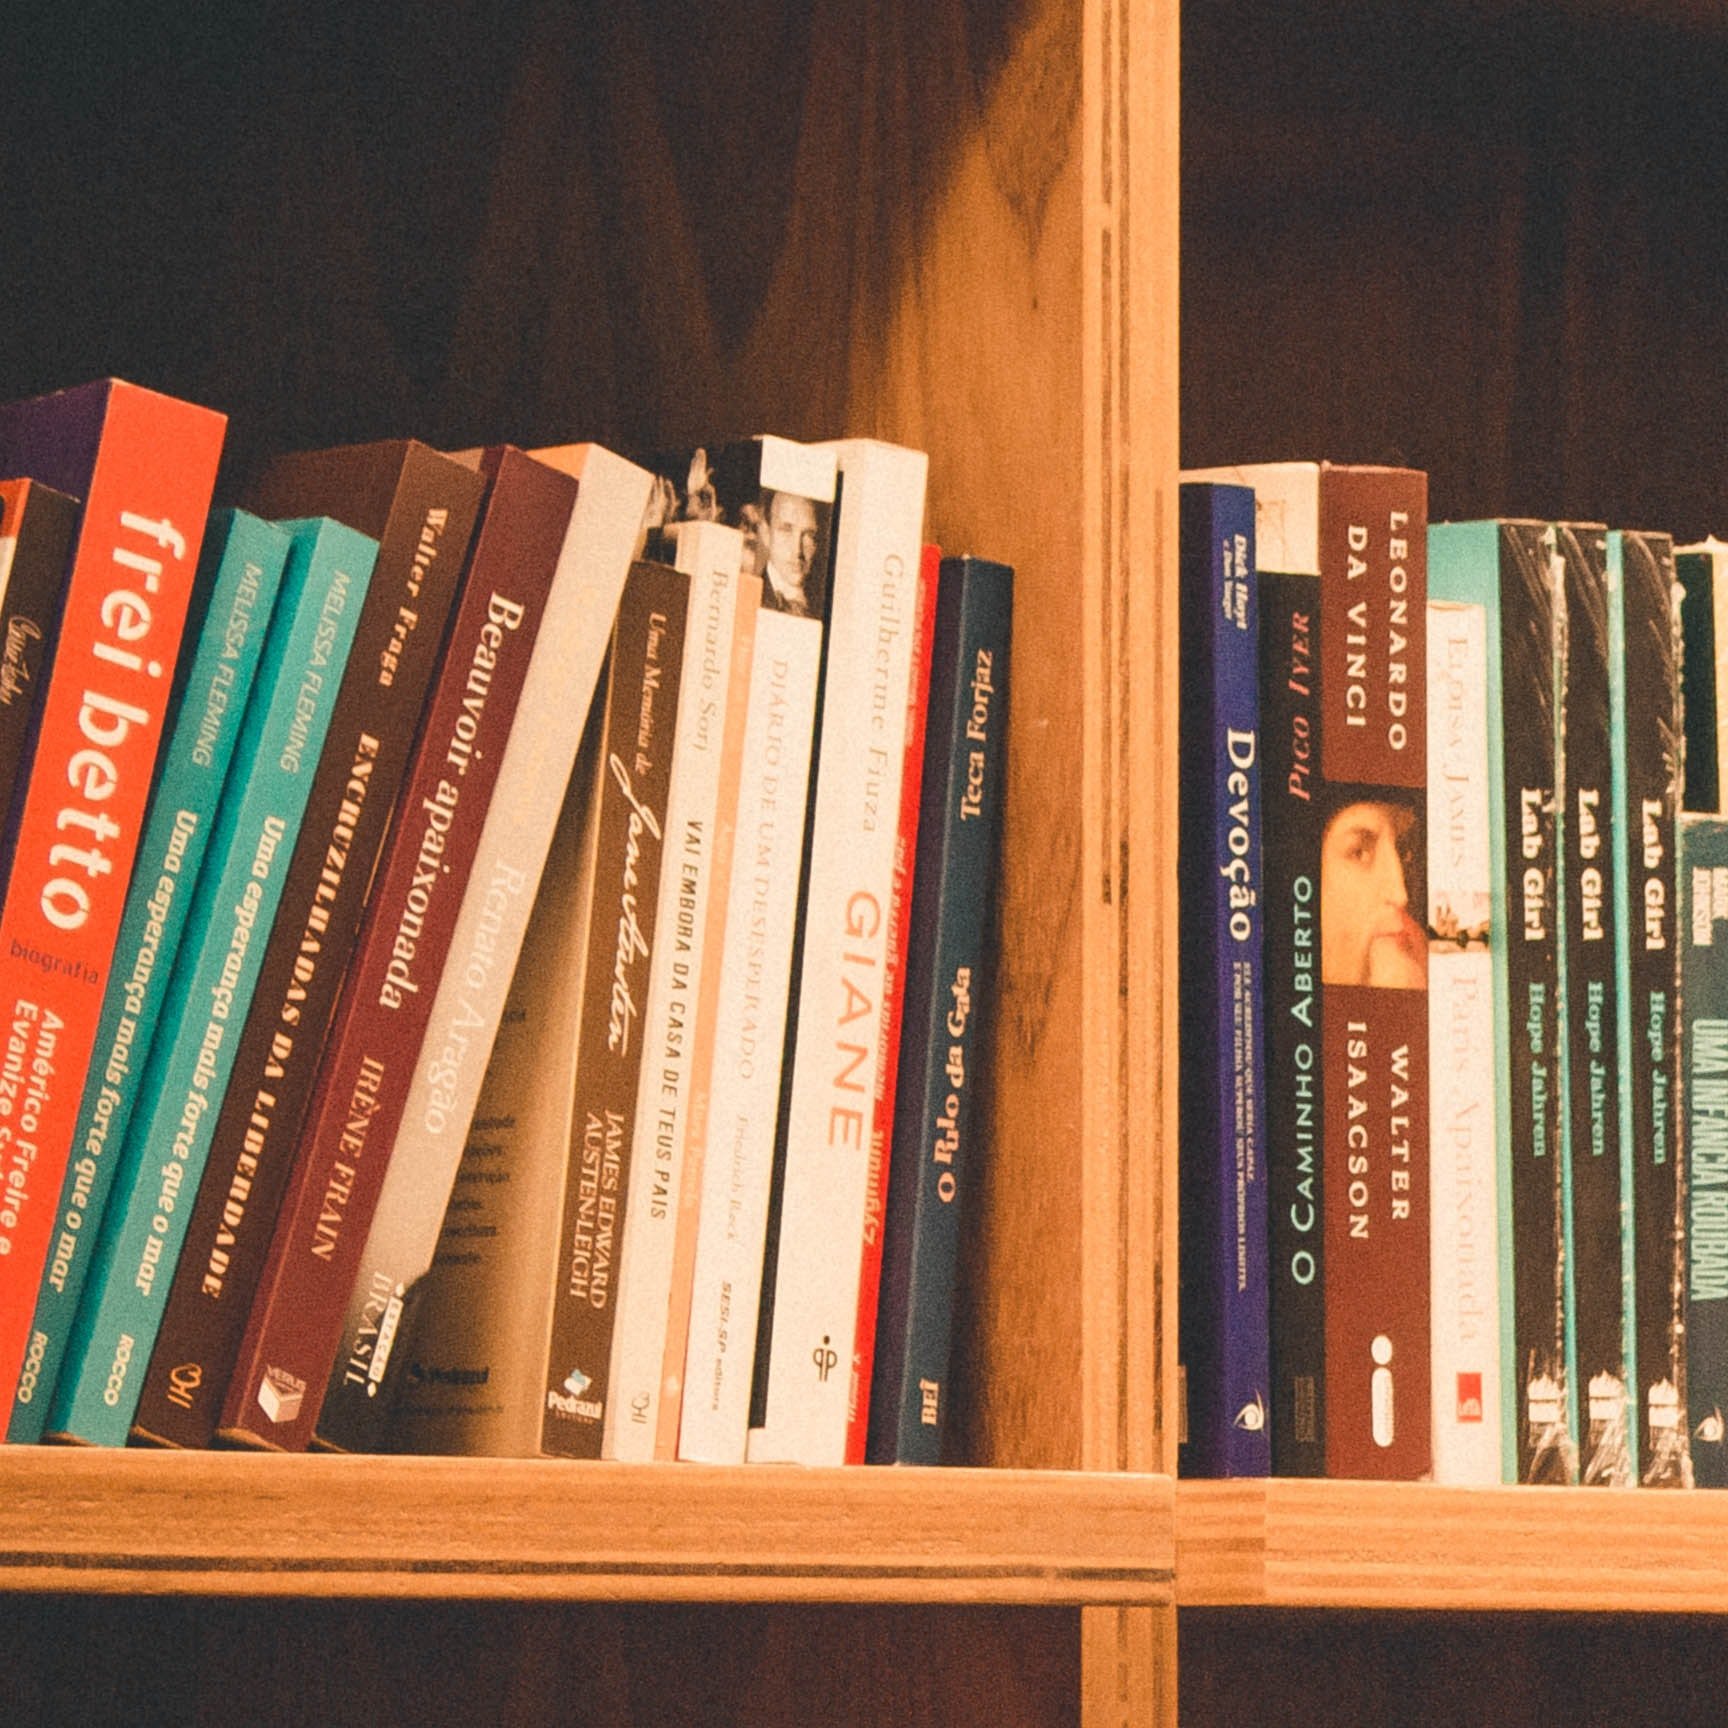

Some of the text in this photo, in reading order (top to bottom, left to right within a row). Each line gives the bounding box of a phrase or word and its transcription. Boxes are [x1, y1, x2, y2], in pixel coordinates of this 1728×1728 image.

[281, 571, 349, 774] MELISSA FLEMING
[378, 508, 449, 688] Walter Fraga
[634, 611, 668, 776] Uma Memória de
[703, 569, 731, 696] Bernardo
[862, 552, 905, 834] Guilherme Fiuza
[1347, 525, 1368, 728] DA VINCI
[1388, 511, 1409, 751] LEONARDO
[41, 511, 186, 930] frei betto
[379, 590, 526, 1011] Beauvoir apaixonada
[961, 648, 995, 821] Teca Forjaz
[1288, 610, 1312, 801] PICO IYER
[464, 862, 526, 991] Renato
[606, 753, 661, 1057] Jane Austen
[1226, 726, 1256, 943] Devoção
[1520, 786, 1546, 942] Lab Girl
[9, 940, 99, 986] biografia
[135, 815, 285, 1298] Uma esperança mais forte que o mar
[201, 732, 380, 1300] ENCRUZILHADAS DA LIBERDADE
[650, 820, 704, 1223] VAI EMBORA DA CASA DE TEUS PAIS
[825, 889, 884, 1152] GIANE
[0, 1008, 64, 1229] Américo Freire
[423, 999, 487, 1135] Aragão
[933, 966, 972, 1203] O Pulo da Gata
[1290, 874, 1315, 1285] O CAMINHO ABERTO
[1346, 1019, 1370, 1240] ISAACSON
[1391, 1044, 1411, 1220] WALTER
[1528, 981, 1547, 1158] Hope Jahren
[310, 1162, 358, 1262] FRAIN
[569, 1110, 605, 1302] AUSTEN-LEIGH
[591, 1109, 625, 1310] JAMES EDWARD
[104, 1332, 136, 1408] ROCCO
